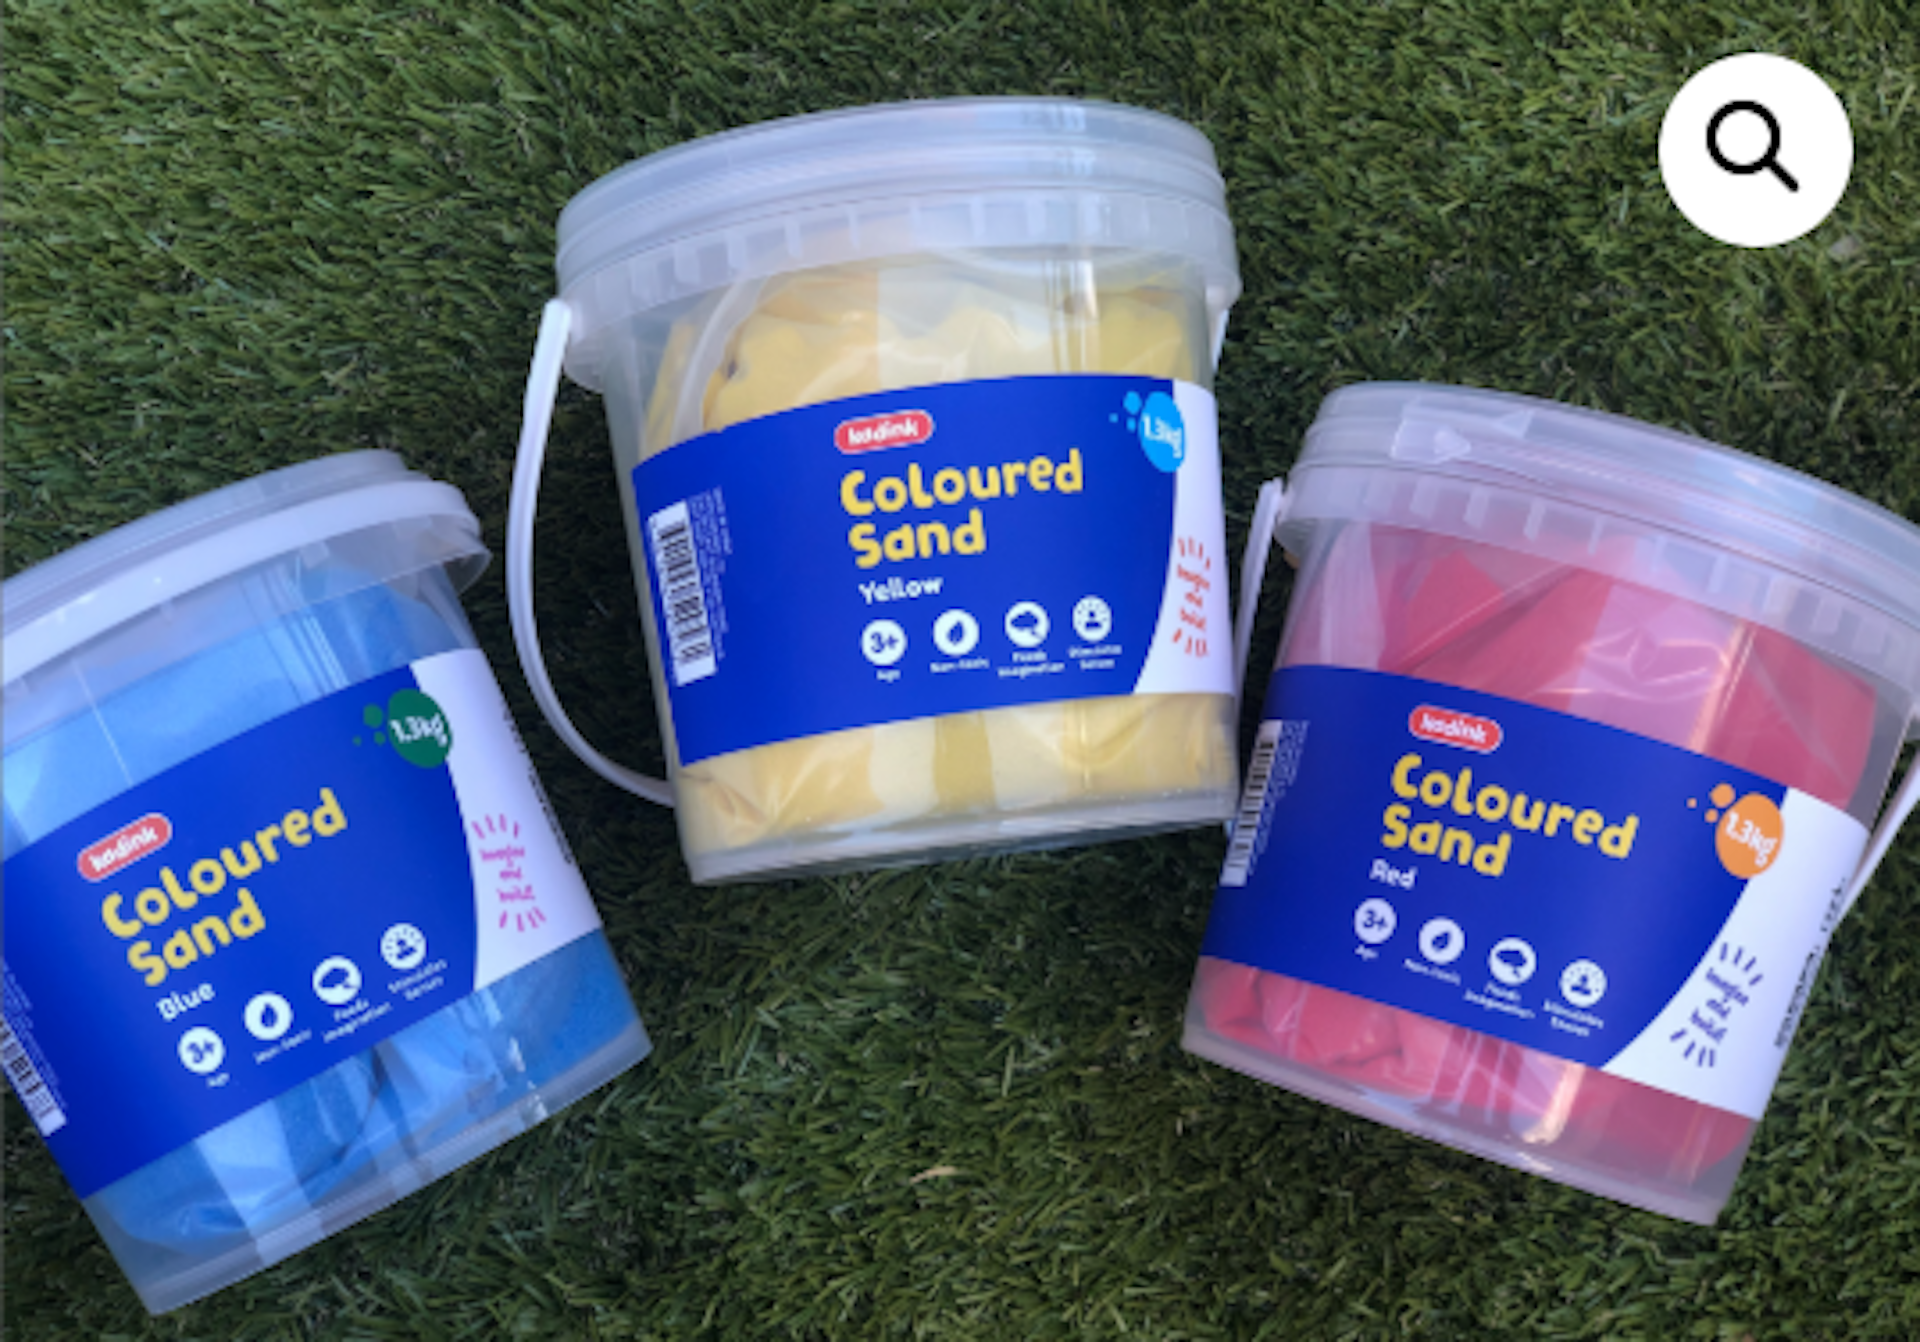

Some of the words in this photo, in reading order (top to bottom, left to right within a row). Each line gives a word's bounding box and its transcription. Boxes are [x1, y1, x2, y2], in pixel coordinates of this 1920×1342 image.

[840, 448, 1083, 515] Coloured
[848, 507, 986, 568] Sand
[858, 577, 943, 605] Yellow
[869, 631, 899, 654] 3+
[389, 712, 448, 747] 1.3kg
[1391, 753, 1639, 859] Coloured
[101, 787, 347, 938] Coloured
[1381, 803, 1511, 877] Sand
[1726, 811, 1778, 868] 1.3kg
[1369, 859, 1417, 890] Red
[127, 887, 266, 987] Sand
[1362, 908, 1389, 932] 3+
[156, 983, 216, 1022] Blue
[186, 1039, 215, 1066] 3+
